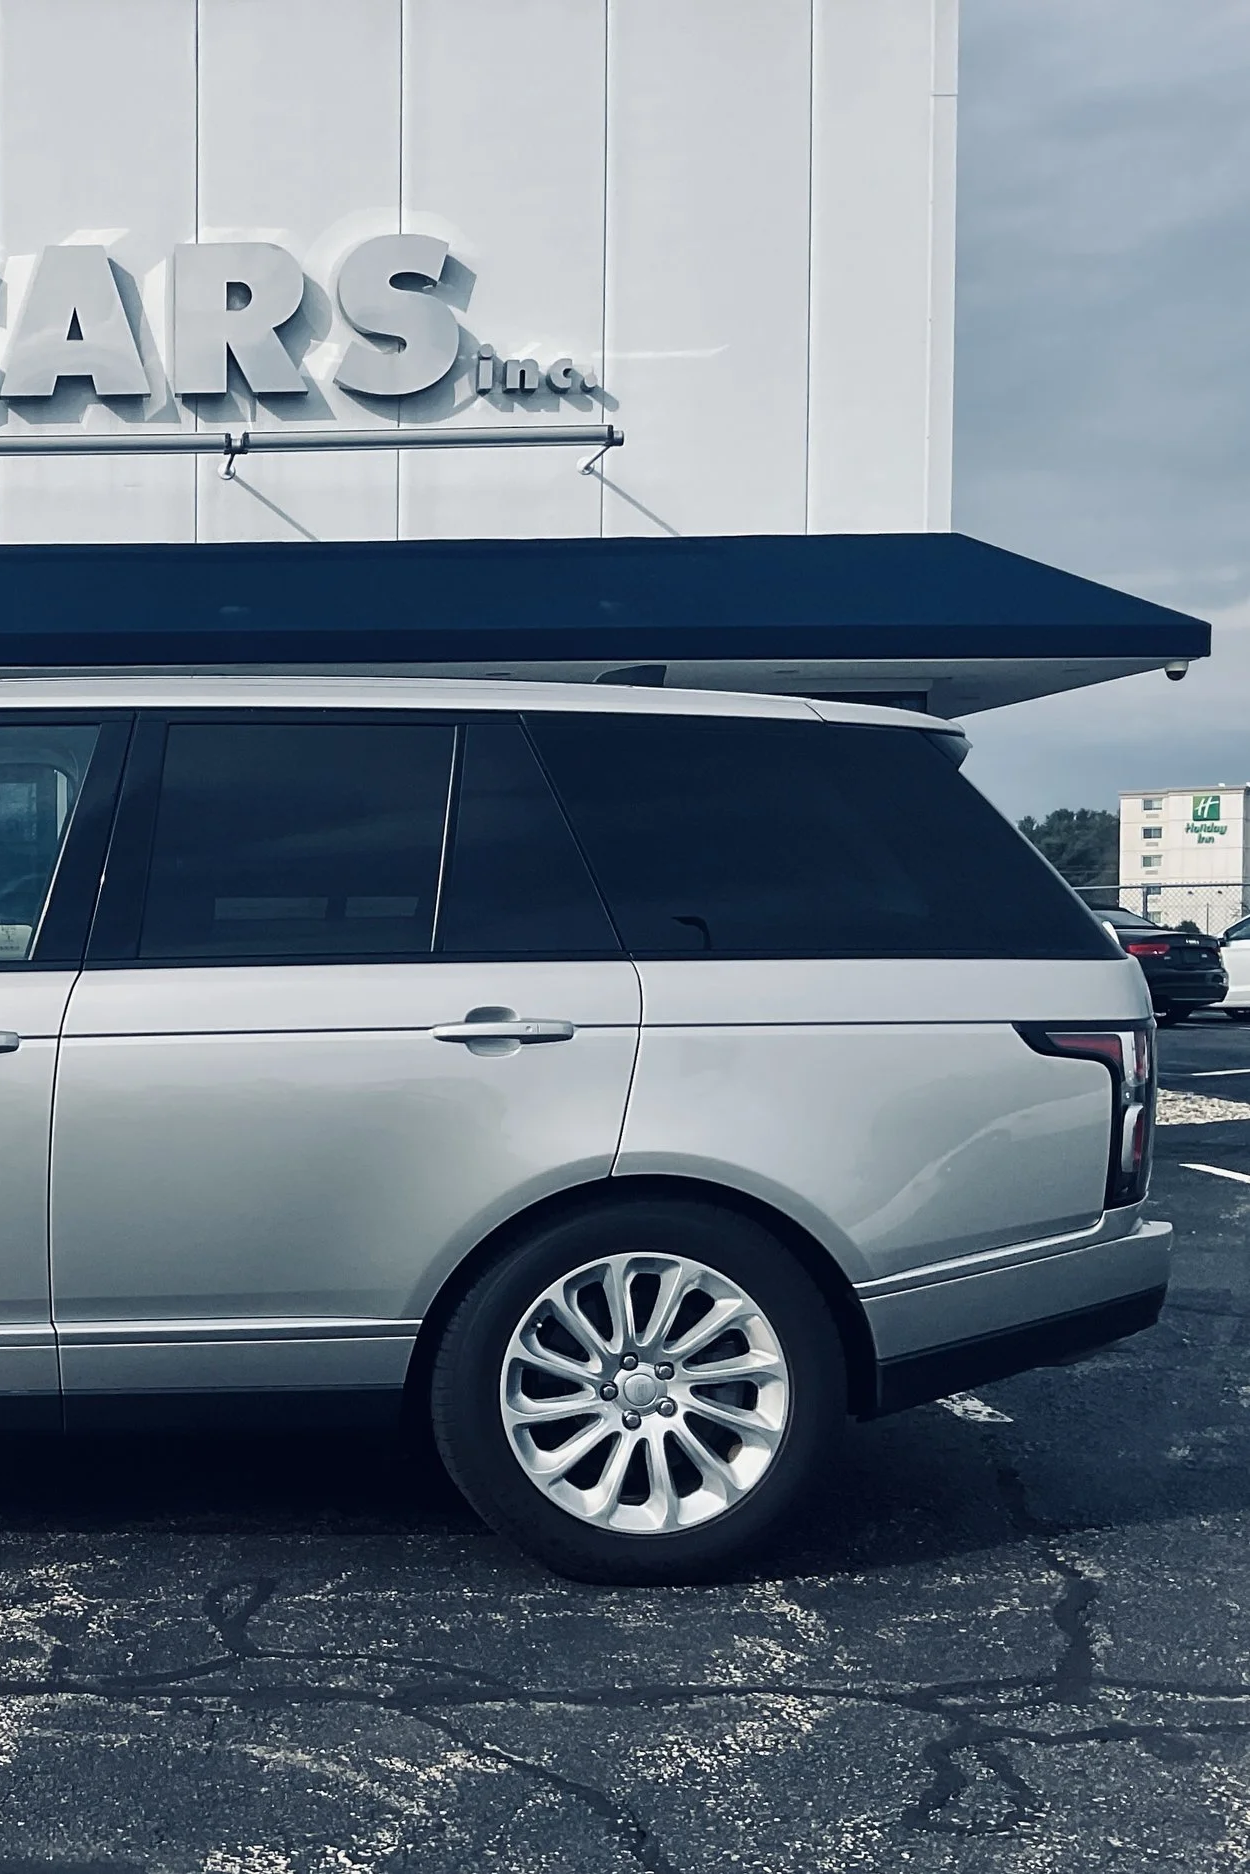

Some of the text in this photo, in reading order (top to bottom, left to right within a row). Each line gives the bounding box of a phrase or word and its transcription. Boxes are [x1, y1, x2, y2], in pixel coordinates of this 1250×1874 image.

[474, 344, 602, 395] inc.
[1185, 823, 1227, 835] Holiday
[1197, 834, 1215, 844] Inn
